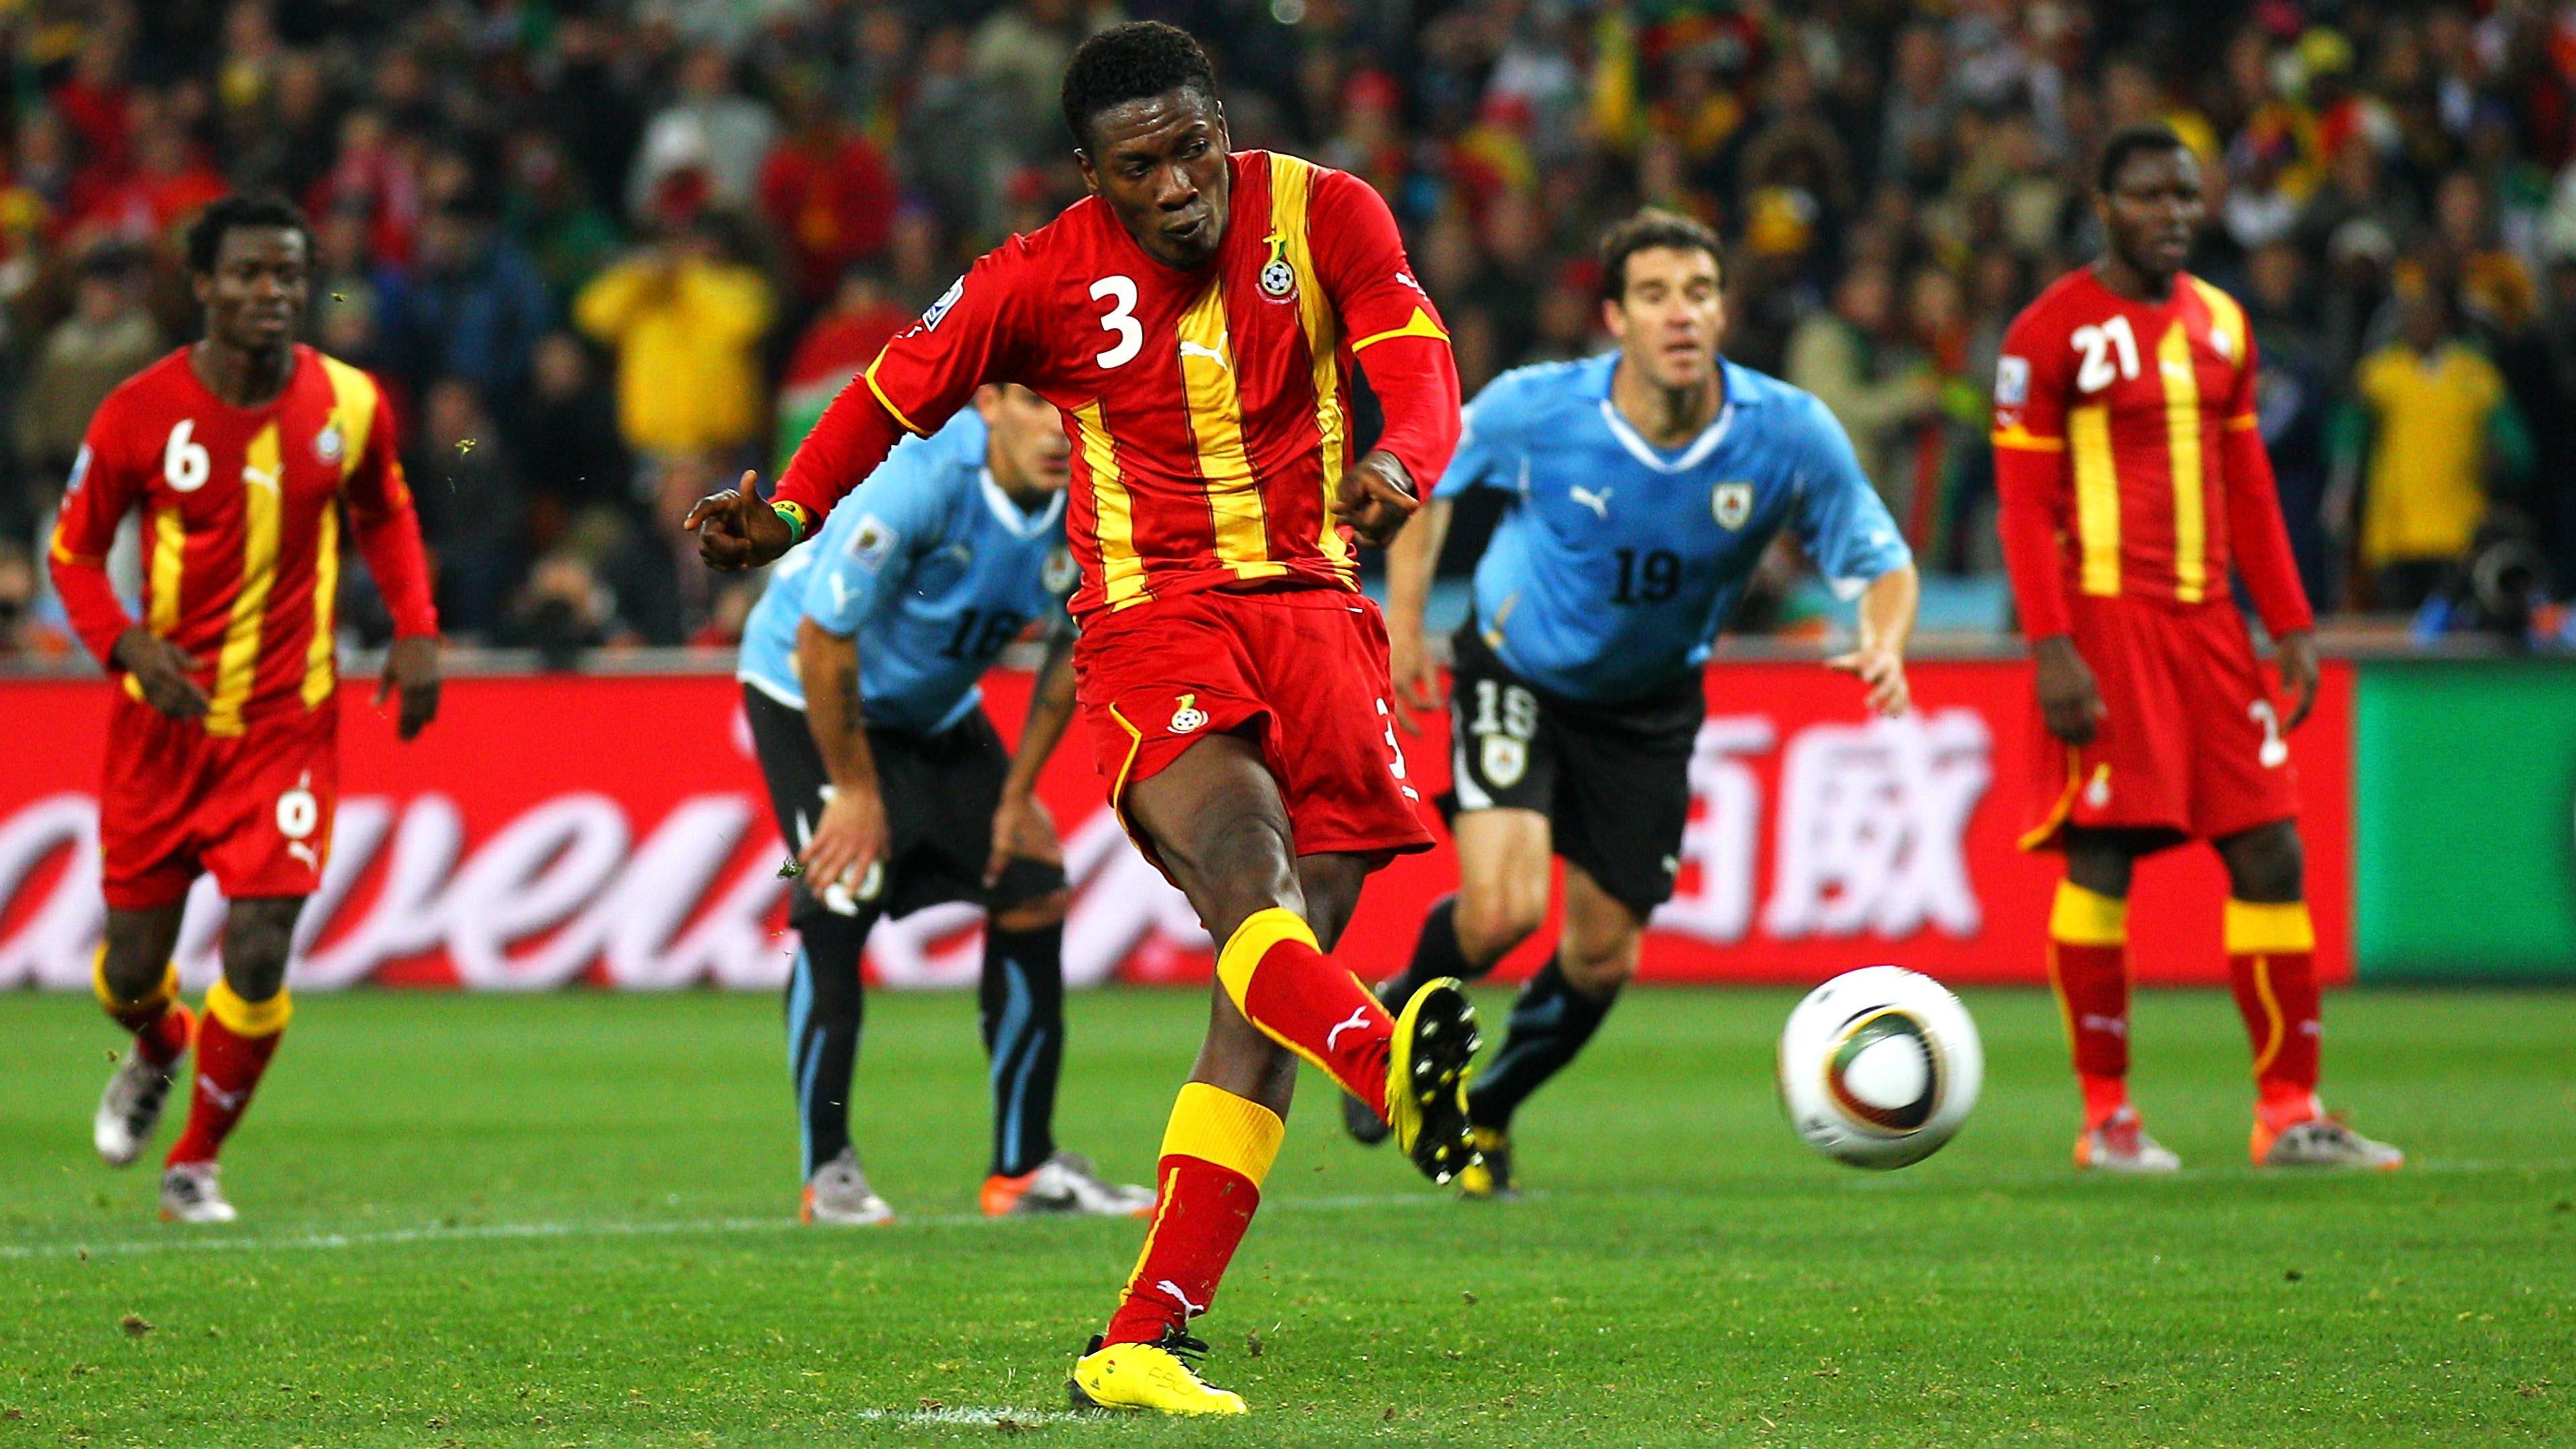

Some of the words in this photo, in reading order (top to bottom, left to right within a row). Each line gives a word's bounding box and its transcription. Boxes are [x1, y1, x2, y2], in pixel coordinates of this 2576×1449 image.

[1089, 275, 1142, 369] 3
[2070, 314, 2141, 393] 21
[164, 417, 211, 493] 6
[1610, 548, 1680, 604] 19
[276, 769, 318, 839] 6
